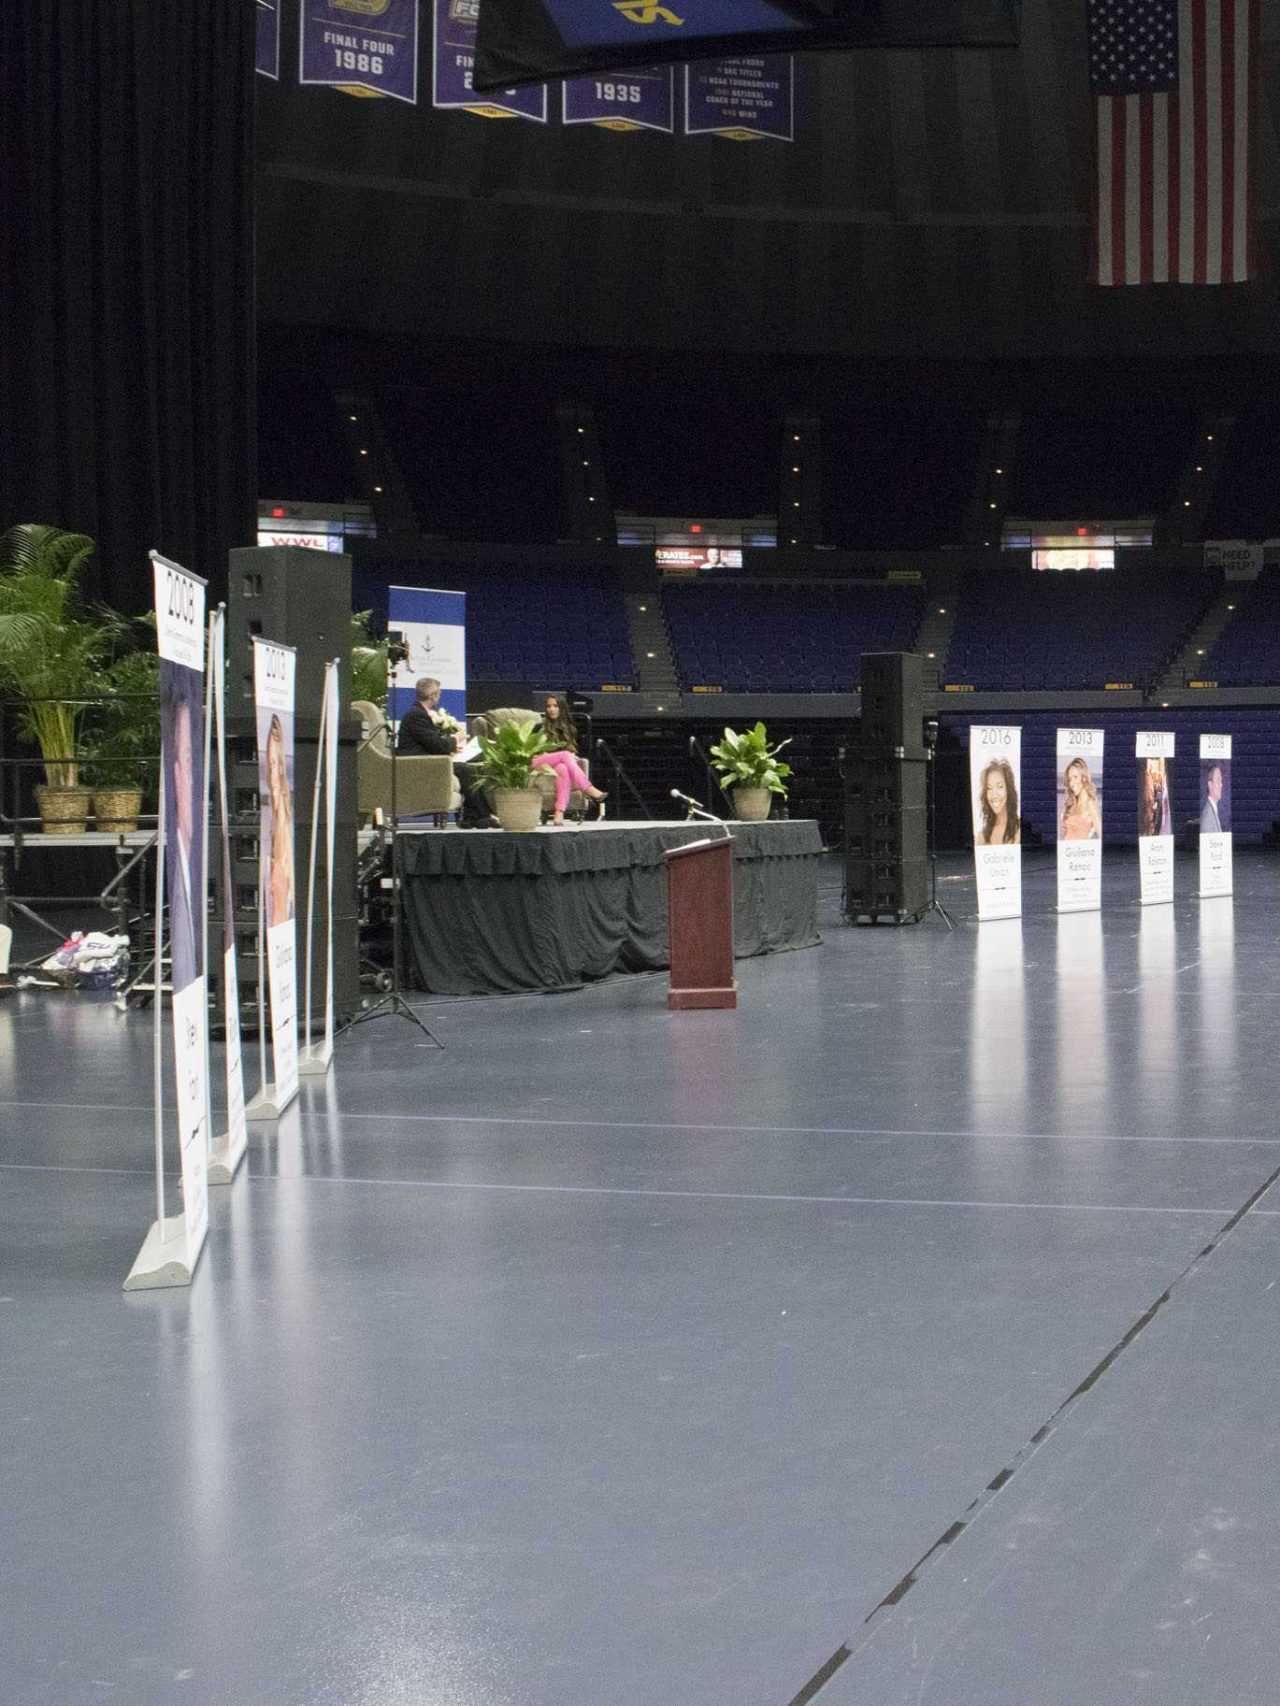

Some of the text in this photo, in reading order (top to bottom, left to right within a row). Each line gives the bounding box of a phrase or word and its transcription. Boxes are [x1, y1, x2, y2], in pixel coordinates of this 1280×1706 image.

[324, 31, 394, 55] FINAL FOUR
[335, 48, 383, 75] 1986
[594, 81, 640, 103] 1935
[981, 728, 1011, 745] 2016
[1069, 731, 1092, 745] 2013
[1146, 734, 1164, 747] 2011
